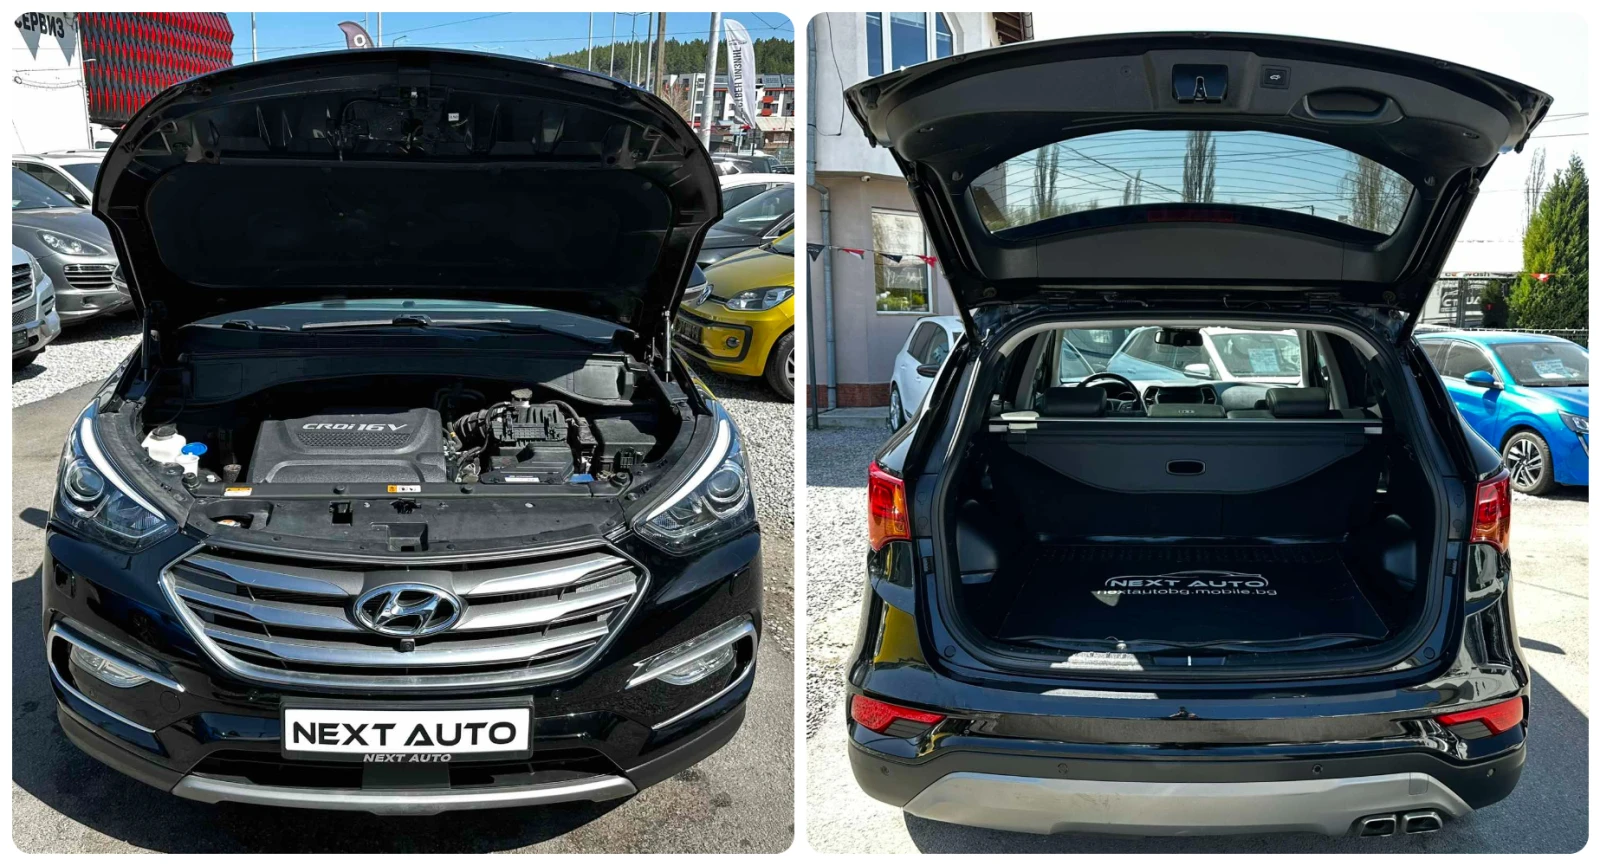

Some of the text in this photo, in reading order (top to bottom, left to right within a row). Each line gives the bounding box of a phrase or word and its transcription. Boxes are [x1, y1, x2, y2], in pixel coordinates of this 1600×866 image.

[1110, 579, 1266, 588] NEXT AUTO
[1097, 588, 1278, 596] nextautobg.mobile.bg
[292, 720, 518, 747] NEXT AUTO
[363, 753, 452, 763] NEXT AUTO
